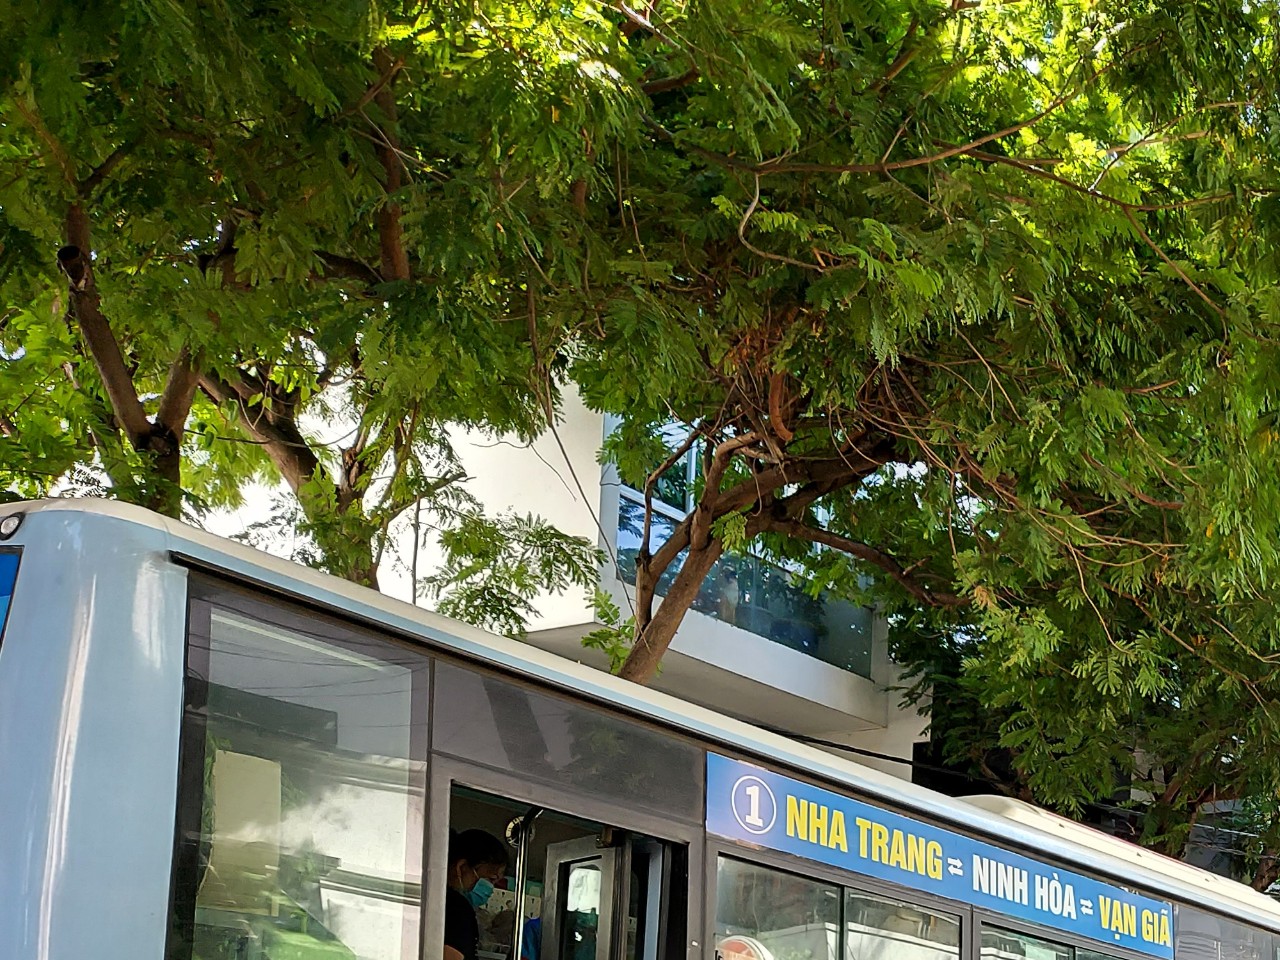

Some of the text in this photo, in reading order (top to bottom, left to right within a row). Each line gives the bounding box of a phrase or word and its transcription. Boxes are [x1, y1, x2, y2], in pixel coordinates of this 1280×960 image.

[745, 785, 1171, 947] 1 NHA TRANG NINH HÒA VẠN GIÃ
